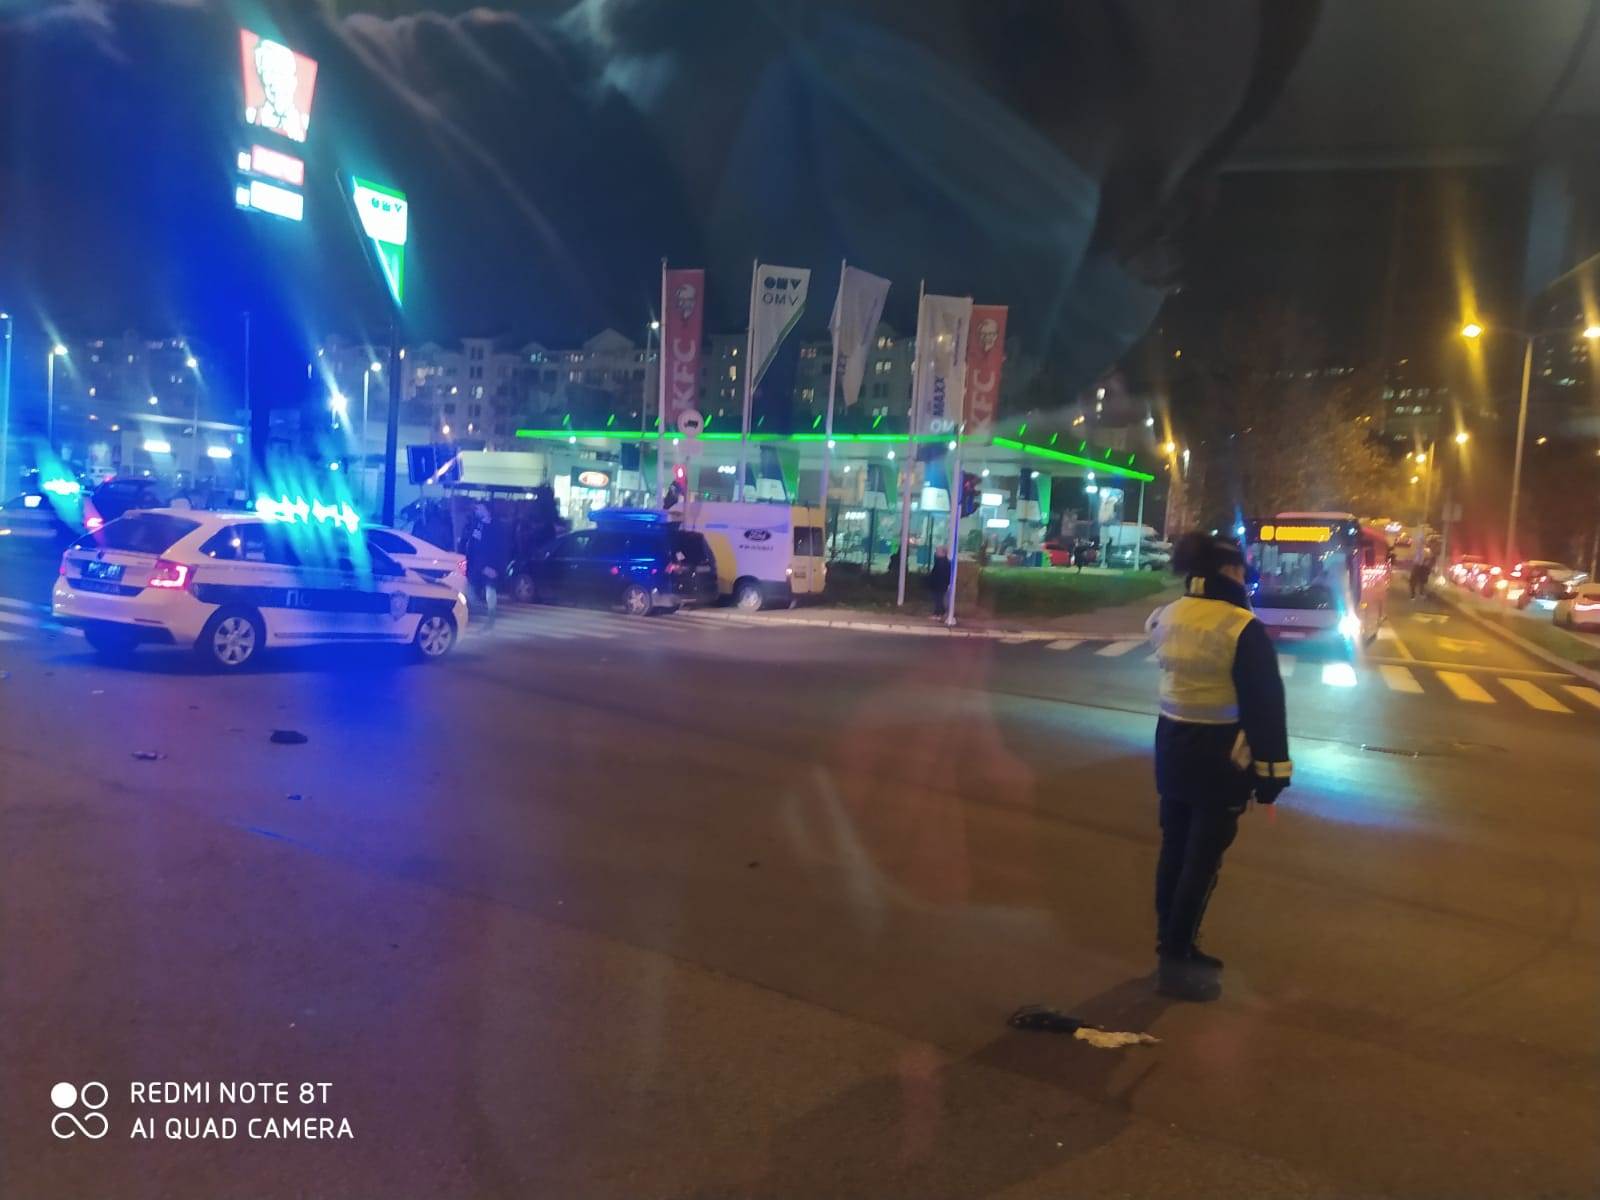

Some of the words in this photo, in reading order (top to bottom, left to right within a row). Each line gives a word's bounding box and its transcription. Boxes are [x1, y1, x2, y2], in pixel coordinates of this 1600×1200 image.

[762, 293, 799, 306] OMV
[764, 276, 802, 290] OMV
[672, 338, 696, 411] KFC
[932, 376, 945, 417] MAXX
[970, 369, 996, 436] KFC
